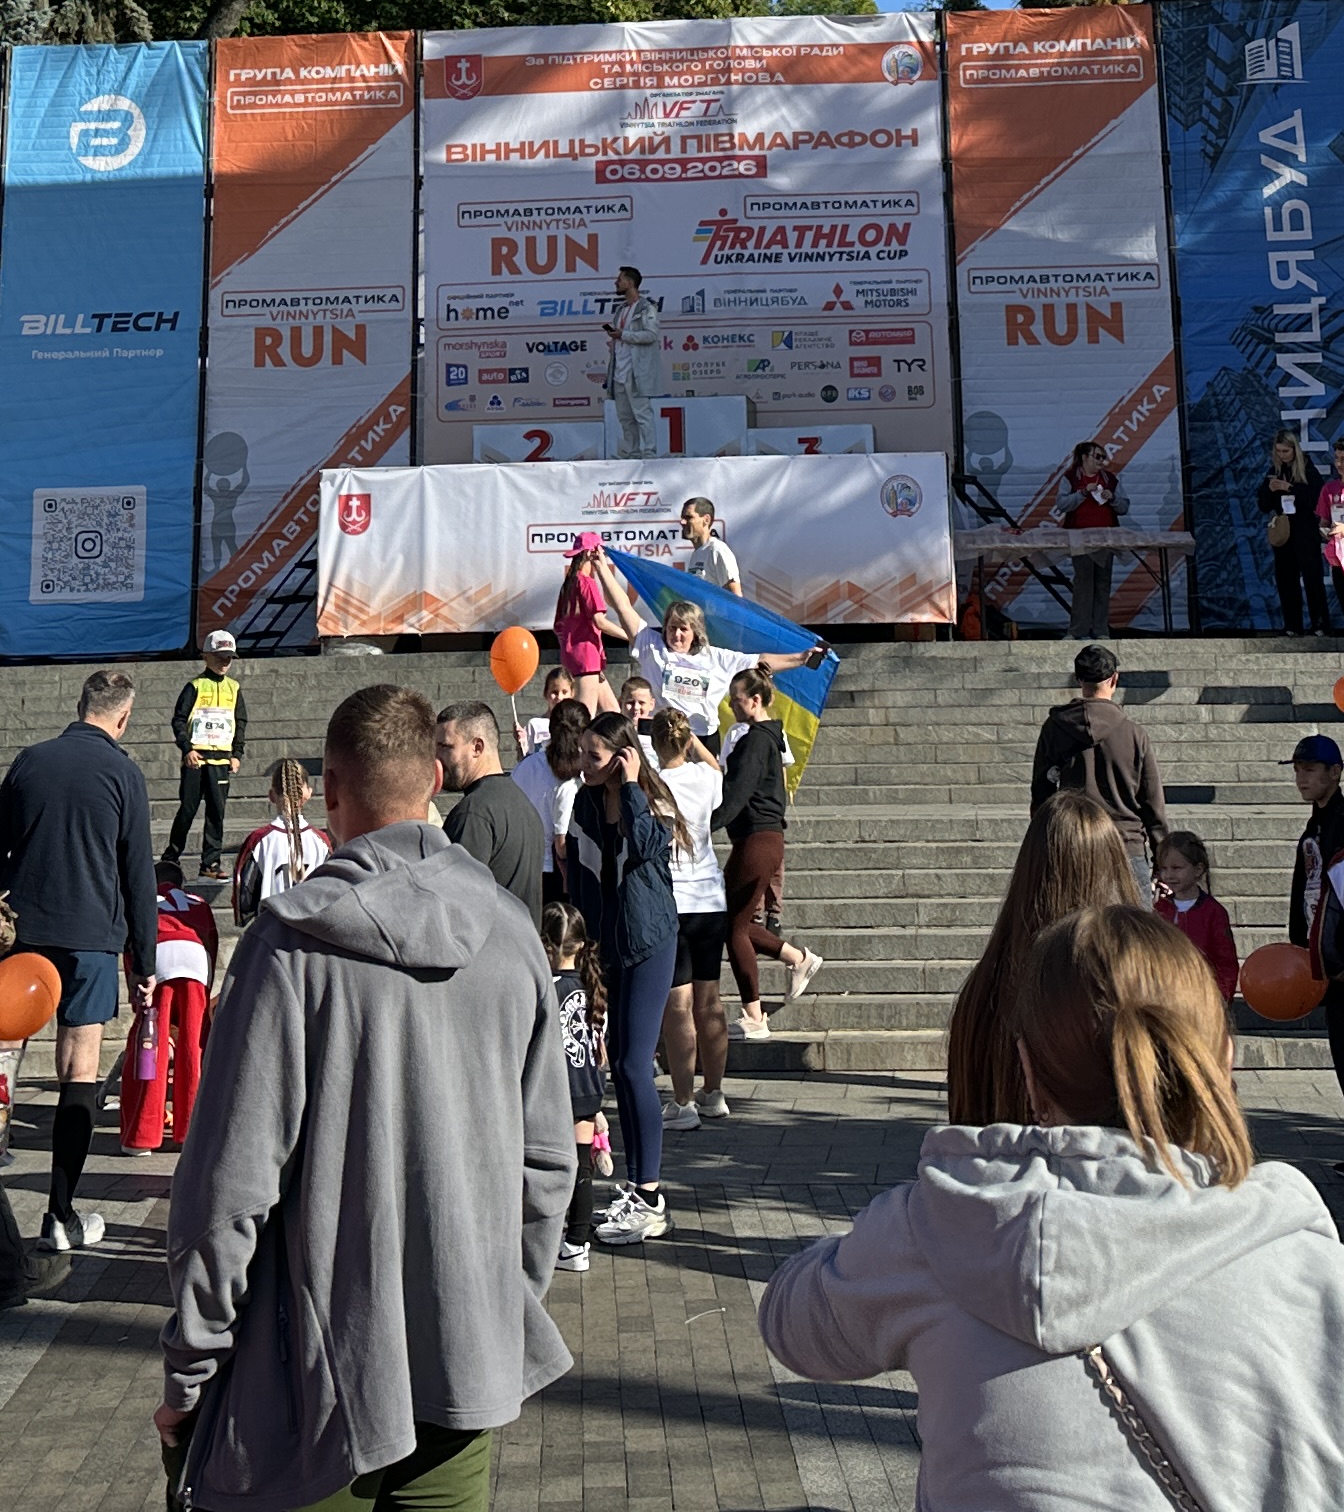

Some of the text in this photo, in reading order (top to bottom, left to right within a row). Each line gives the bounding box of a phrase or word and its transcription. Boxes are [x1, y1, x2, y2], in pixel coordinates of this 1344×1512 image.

[960, 35, 1142, 56] ГРУПА КОМПАНІЙ
[548, 52, 637, 66] ПІДТРИМКИ
[641, 45, 732, 62] ВІННИЦЬКОЇ
[735, 45, 797, 58] МІСЬКОЇ
[800, 46, 844, 57] РАДИ
[229, 61, 404, 82] ГРУПА КОМПАНІЙ
[602, 59, 767, 74] ТА МІСЬКОГО ГОЛОВИ
[966, 64, 1139, 80] ПРОМАВТОМАТИКА
[589, 72, 786, 90] СЕРГІЯ МОРГУНОВА
[233, 90, 399, 107] ПРОМАВТОМАТИКА
[662, 99, 721, 118] VFT
[696, 118, 738, 127] FEDERATION
[445, 128, 919, 164] ВІННИЦЬКИЙ ПІВМАРАФОН
[605, 159, 758, 182] 06.09.2026
[461, 204, 630, 220] ПРОМАВТОМАТИКА
[750, 198, 916, 212] ПРОМАВТОМАТИКА
[504, 218, 588, 232] VINNYTSIA
[698, 217, 912, 265] TRIATHLON
[491, 233, 600, 276] RUN
[713, 249, 909, 265] UKRAINE VINNYTSIA CUP
[972, 271, 1156, 287] ПРОМАВТОМАТИКА
[855, 287, 918, 298] MITSUBISHI
[1018, 286, 1111, 299] VINNYTSIA
[225, 293, 401, 310] ПРОМАВТОМАТИКА
[713, 296, 809, 308] ВІННИЦЯБУД
[864, 299, 910, 309] MOTORS
[269, 308, 357, 322] VINNYTSIA
[19, 311, 180, 336] BILLTECH
[1005, 302, 1125, 347] RUN
[253, 324, 367, 368] RUN
[525, 340, 587, 354] VOLTAGE
[702, 334, 755, 345] КОНЕКС
[31, 347, 164, 361] Генеральний Партнер
[449, 367, 465, 379] 20
[893, 359, 928, 373] TYR
[481, 372, 504, 381] auto
[660, 407, 686, 454] 1
[522, 429, 554, 461] 2
[613, 491, 659, 507] VFT
[211, 403, 407, 618] ПРОМАВТОАТИКА
[532, 529, 721, 544] ПРОВТОМАТА
